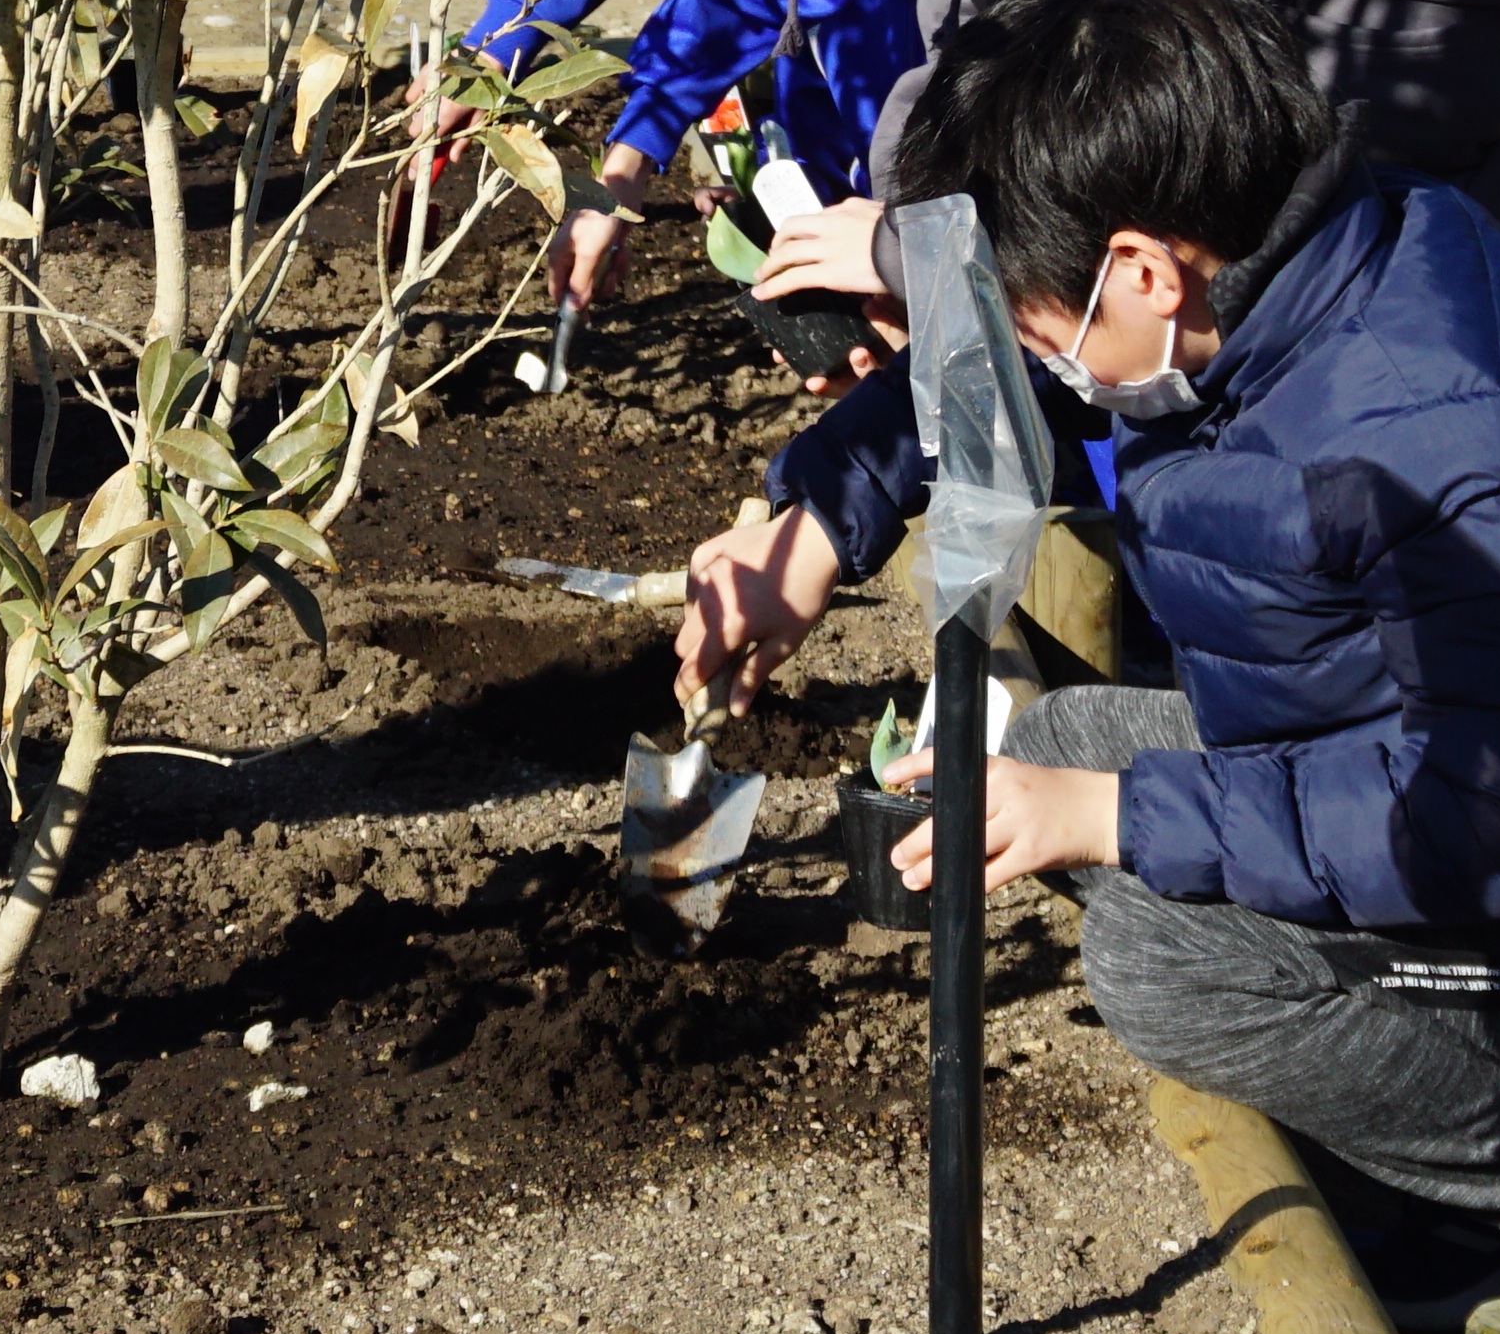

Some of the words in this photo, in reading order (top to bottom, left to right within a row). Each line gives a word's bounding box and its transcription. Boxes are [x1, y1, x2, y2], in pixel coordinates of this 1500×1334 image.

[1403, 963, 1429, 975] ENJOY
[1381, 976, 1403, 988] WEST
[1420, 977, 1434, 989] ON
